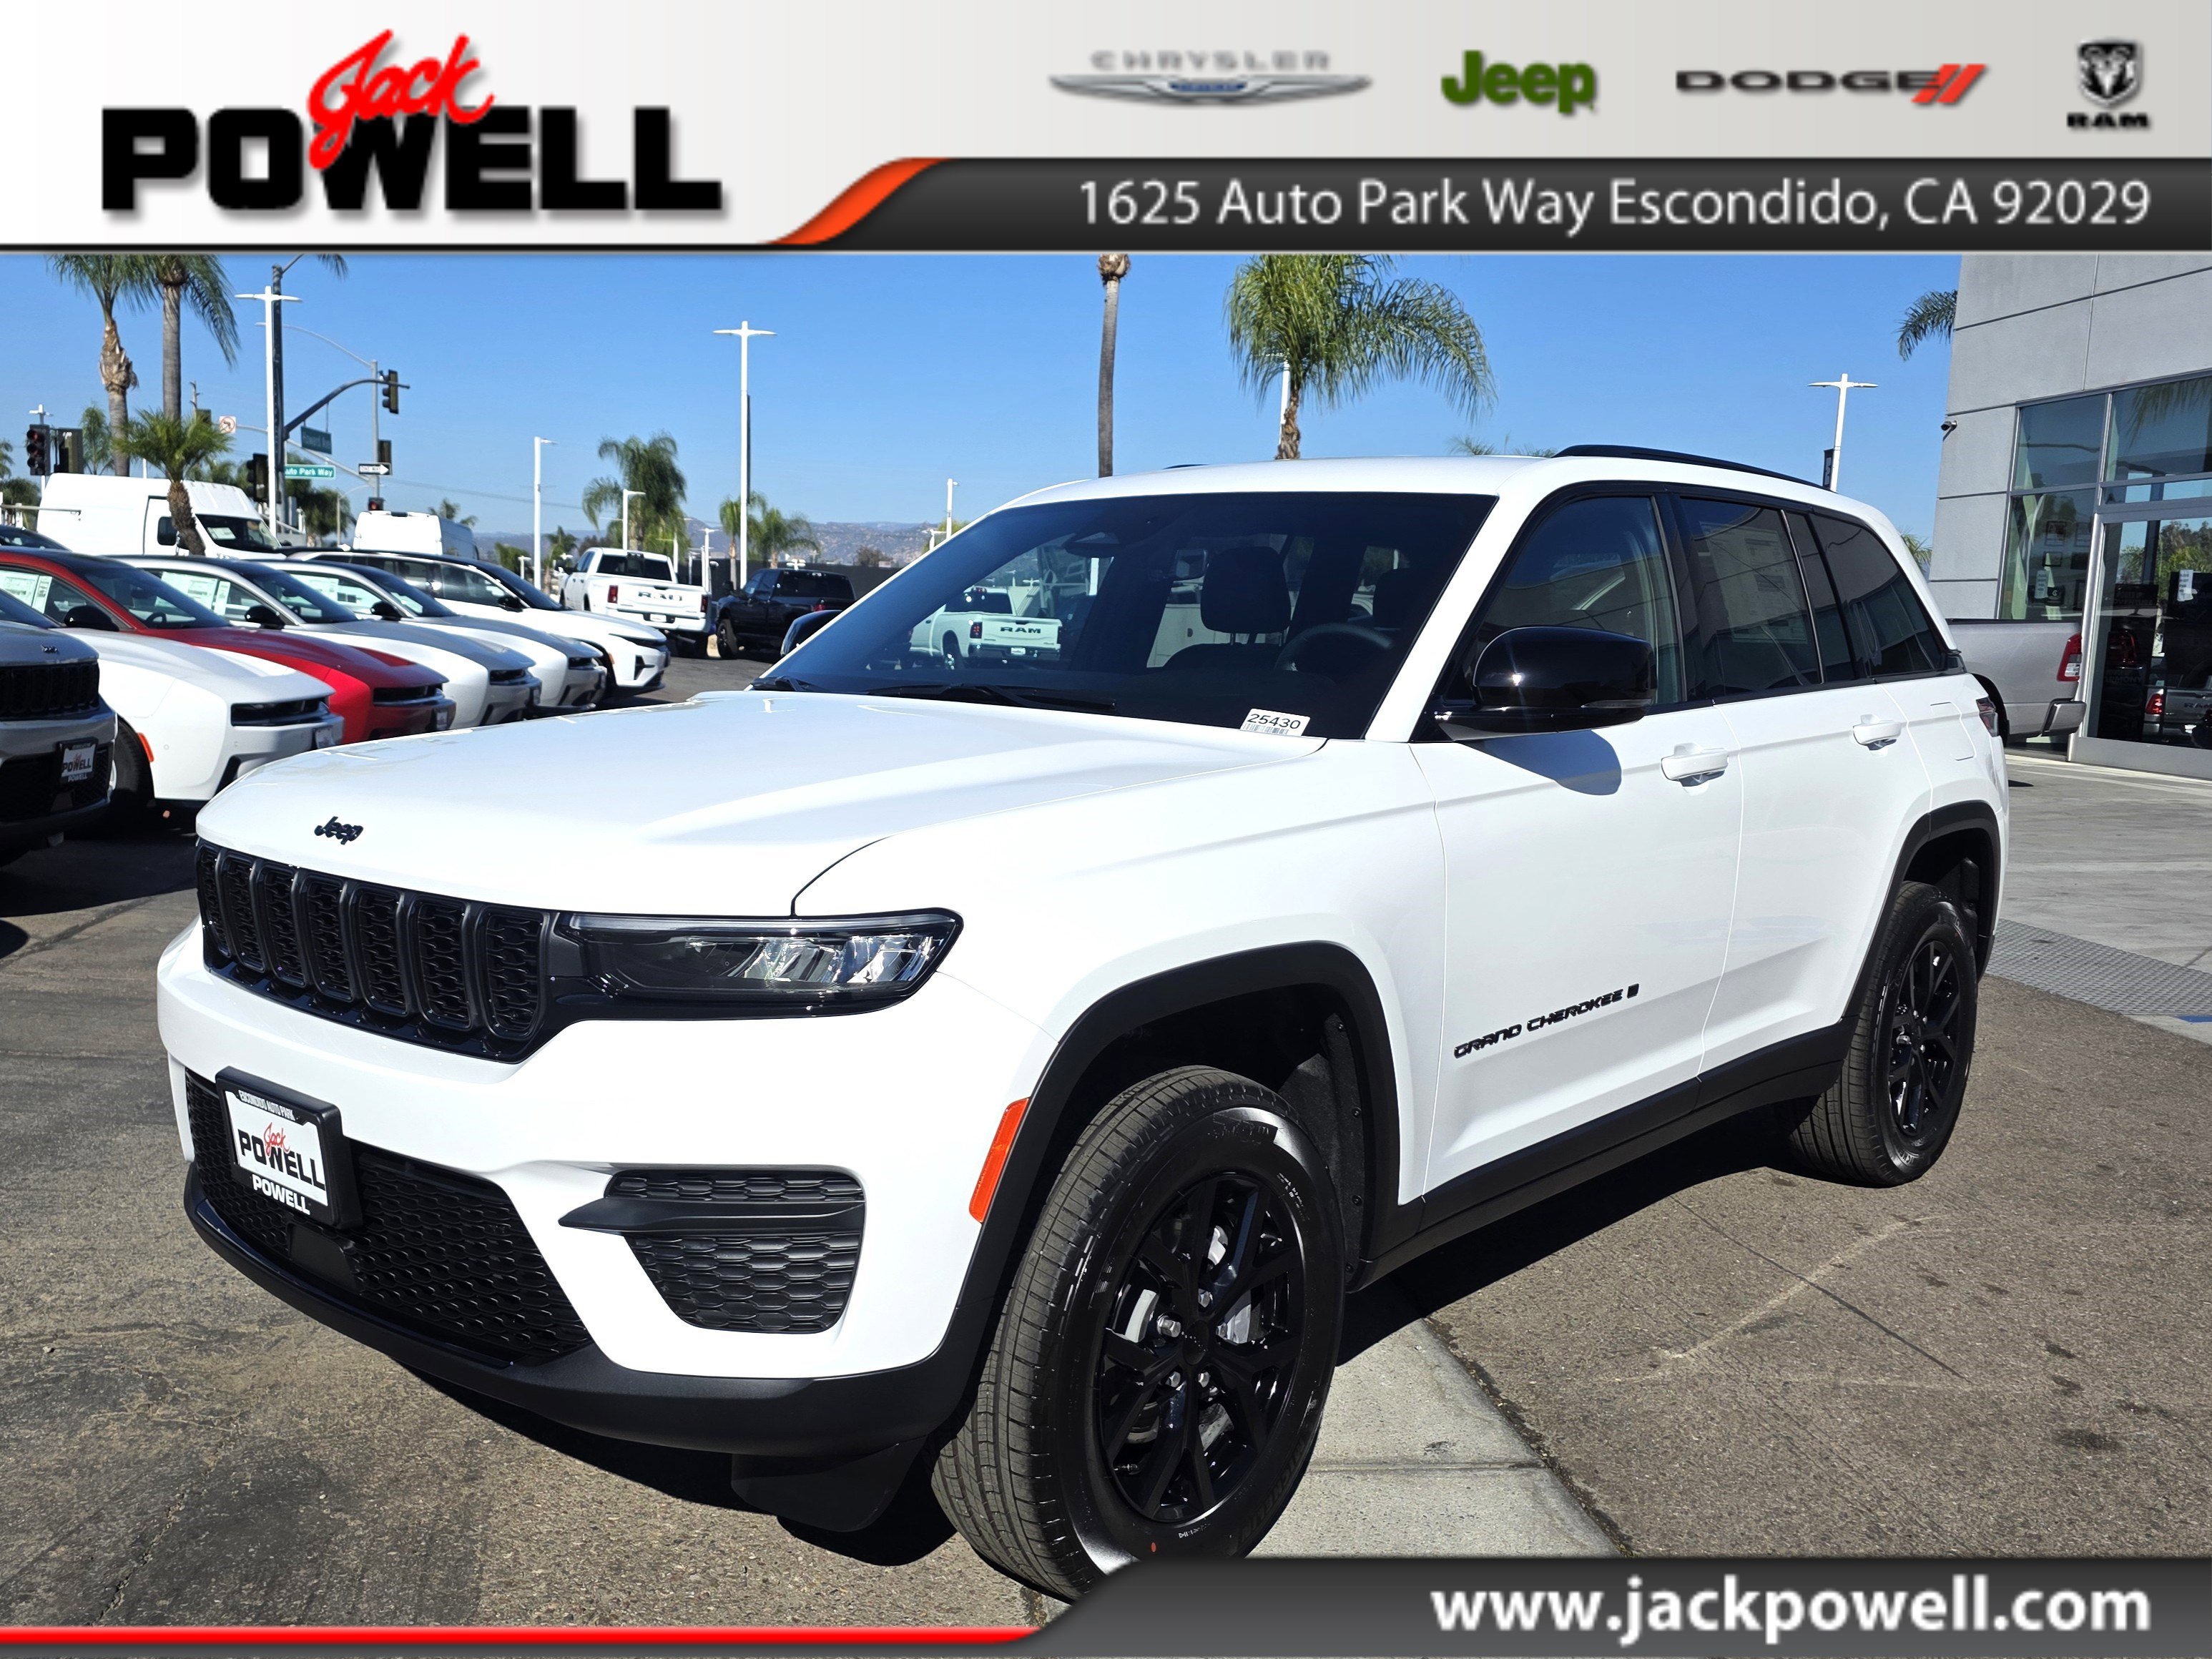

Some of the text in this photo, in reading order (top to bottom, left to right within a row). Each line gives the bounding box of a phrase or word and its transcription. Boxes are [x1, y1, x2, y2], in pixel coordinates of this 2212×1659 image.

[318, 468, 333, 477] Way
[1247, 714, 1301, 729] 25430
[314, 816, 364, 846] Jeep
[1454, 988, 1624, 1059] GRAND CHEROKEE
[263, 1121, 290, 1157] Jack
[237, 1128, 326, 1191] POWELL
[252, 1173, 311, 1216] POWELL
